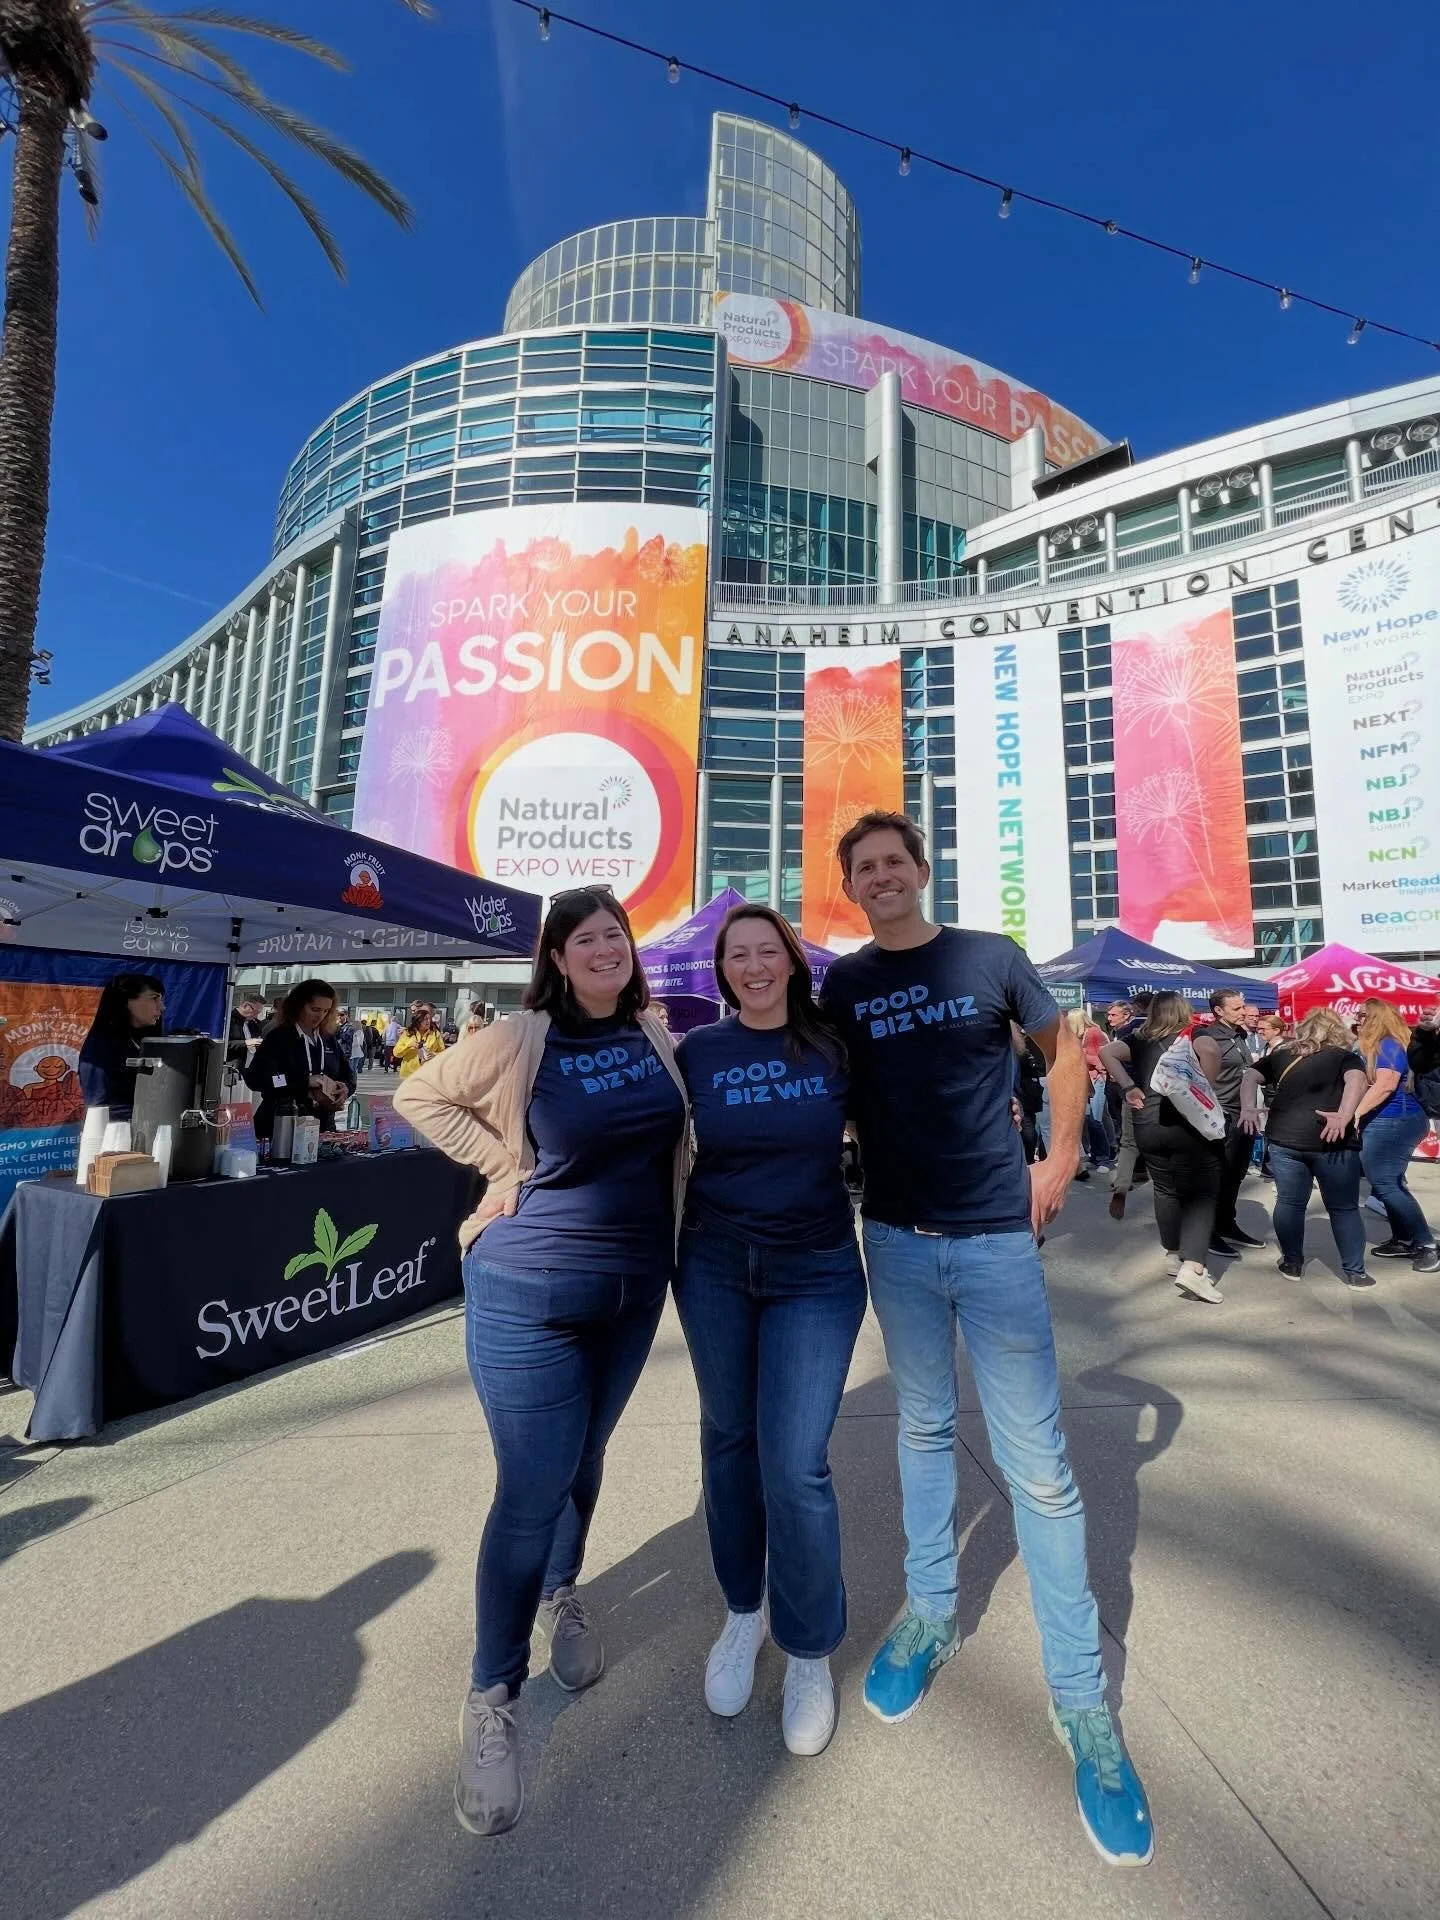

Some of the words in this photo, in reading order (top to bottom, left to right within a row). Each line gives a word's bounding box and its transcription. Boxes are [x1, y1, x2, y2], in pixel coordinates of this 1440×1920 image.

[723, 311, 770, 327] Natural
[723, 322, 781, 339] Products
[926, 369, 996, 420] YOUR
[727, 623, 900, 647] ANAHEIM
[939, 560, 1249, 638] CONVENTION
[1307, 502, 1440, 565] CEN
[430, 593, 530, 627] SPARK
[543, 589, 637, 617] YOUR
[1323, 626, 1370, 645] New
[1376, 609, 1438, 633] Hope
[374, 630, 695, 709] PASSION
[993, 644, 1018, 702] NEW
[1346, 660, 1408, 682] Natural
[1347, 671, 1425, 694] Products
[1353, 709, 1410, 730] NEXT
[996, 711, 1022, 788] HOPE
[1360, 741, 1408, 760] NFM
[1366, 773, 1407, 791] NBJ
[84, 792, 219, 844] sweet
[499, 797, 609, 822] Natural
[1368, 806, 1411, 824] NBJ
[497, 825, 633, 850] Products
[343, 851, 367, 867] MONK
[368, 854, 386, 876] FRUIT
[1368, 846, 1417, 862] NCN
[496, 858, 560, 877] EXPO
[566, 858, 636, 879] WEST
[464, 894, 508, 916] Water
[855, 985, 928, 1021] FOOD
[870, 1012, 914, 1038] BIZ
[916, 996, 978, 1025] WIZ
[4, 1021, 54, 1043] MONK
[559, 1047, 629, 1075] FOOD
[581, 1071, 625, 1093] BIZ
[622, 1055, 663, 1081] WIZ
[712, 1061, 787, 1088] FOOD
[726, 1085, 772, 1105] BIZ
[773, 1077, 828, 1099] WIZ
[196, 1240, 430, 1360] SweetLeaf
